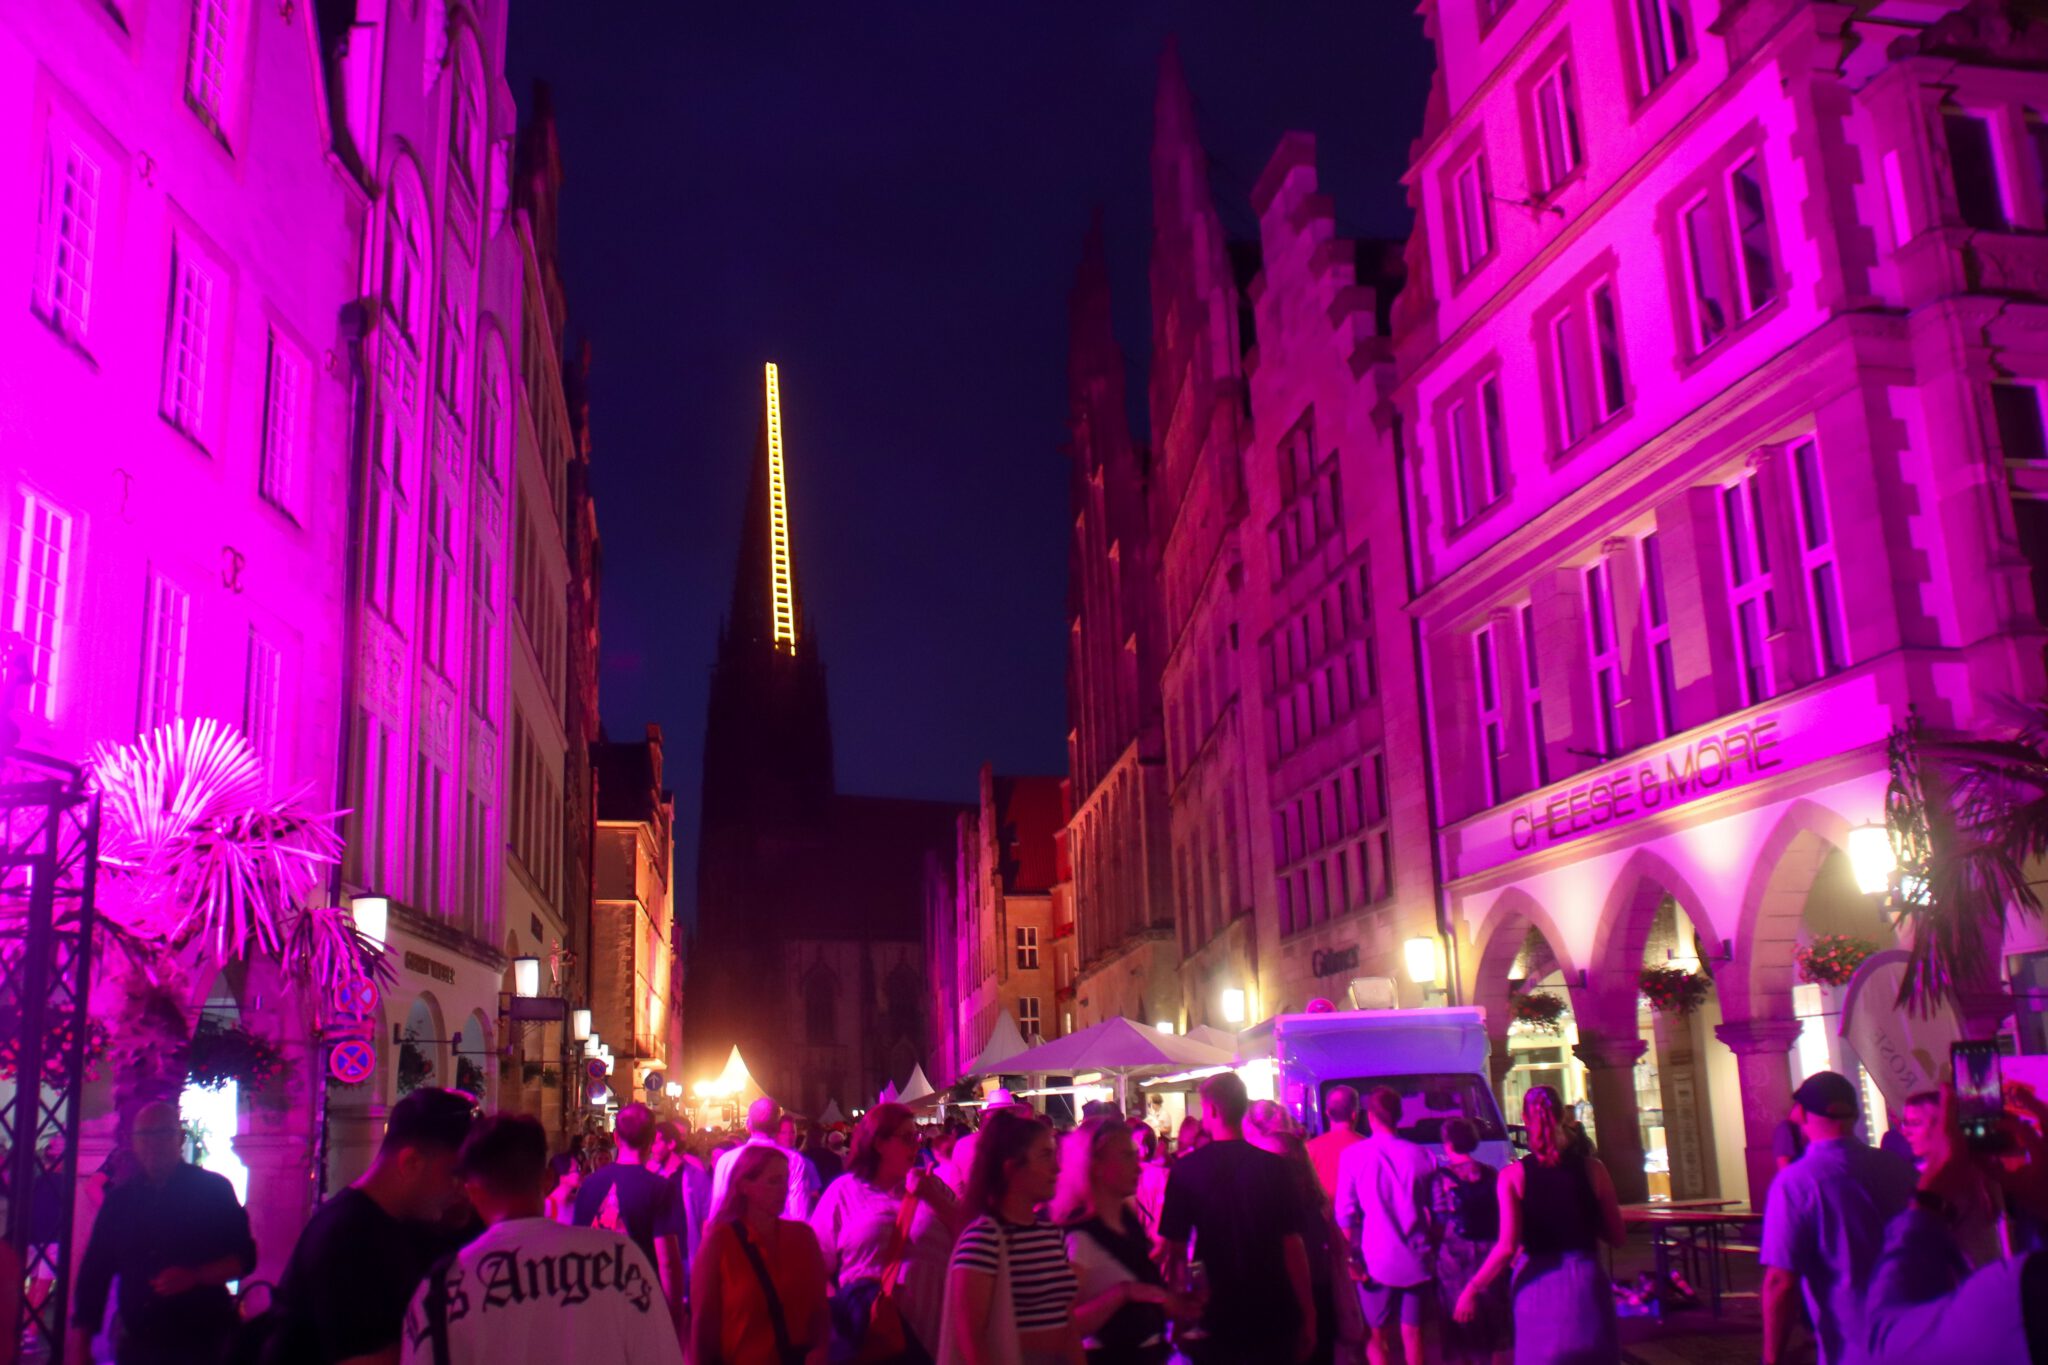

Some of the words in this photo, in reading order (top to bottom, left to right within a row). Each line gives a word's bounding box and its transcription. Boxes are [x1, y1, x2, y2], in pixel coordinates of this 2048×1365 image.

[1511, 775, 1635, 851] CHEESE
[1639, 768, 1662, 809] &
[1666, 720, 1783, 800] MORE
[476, 1244, 653, 1314] Angeles
